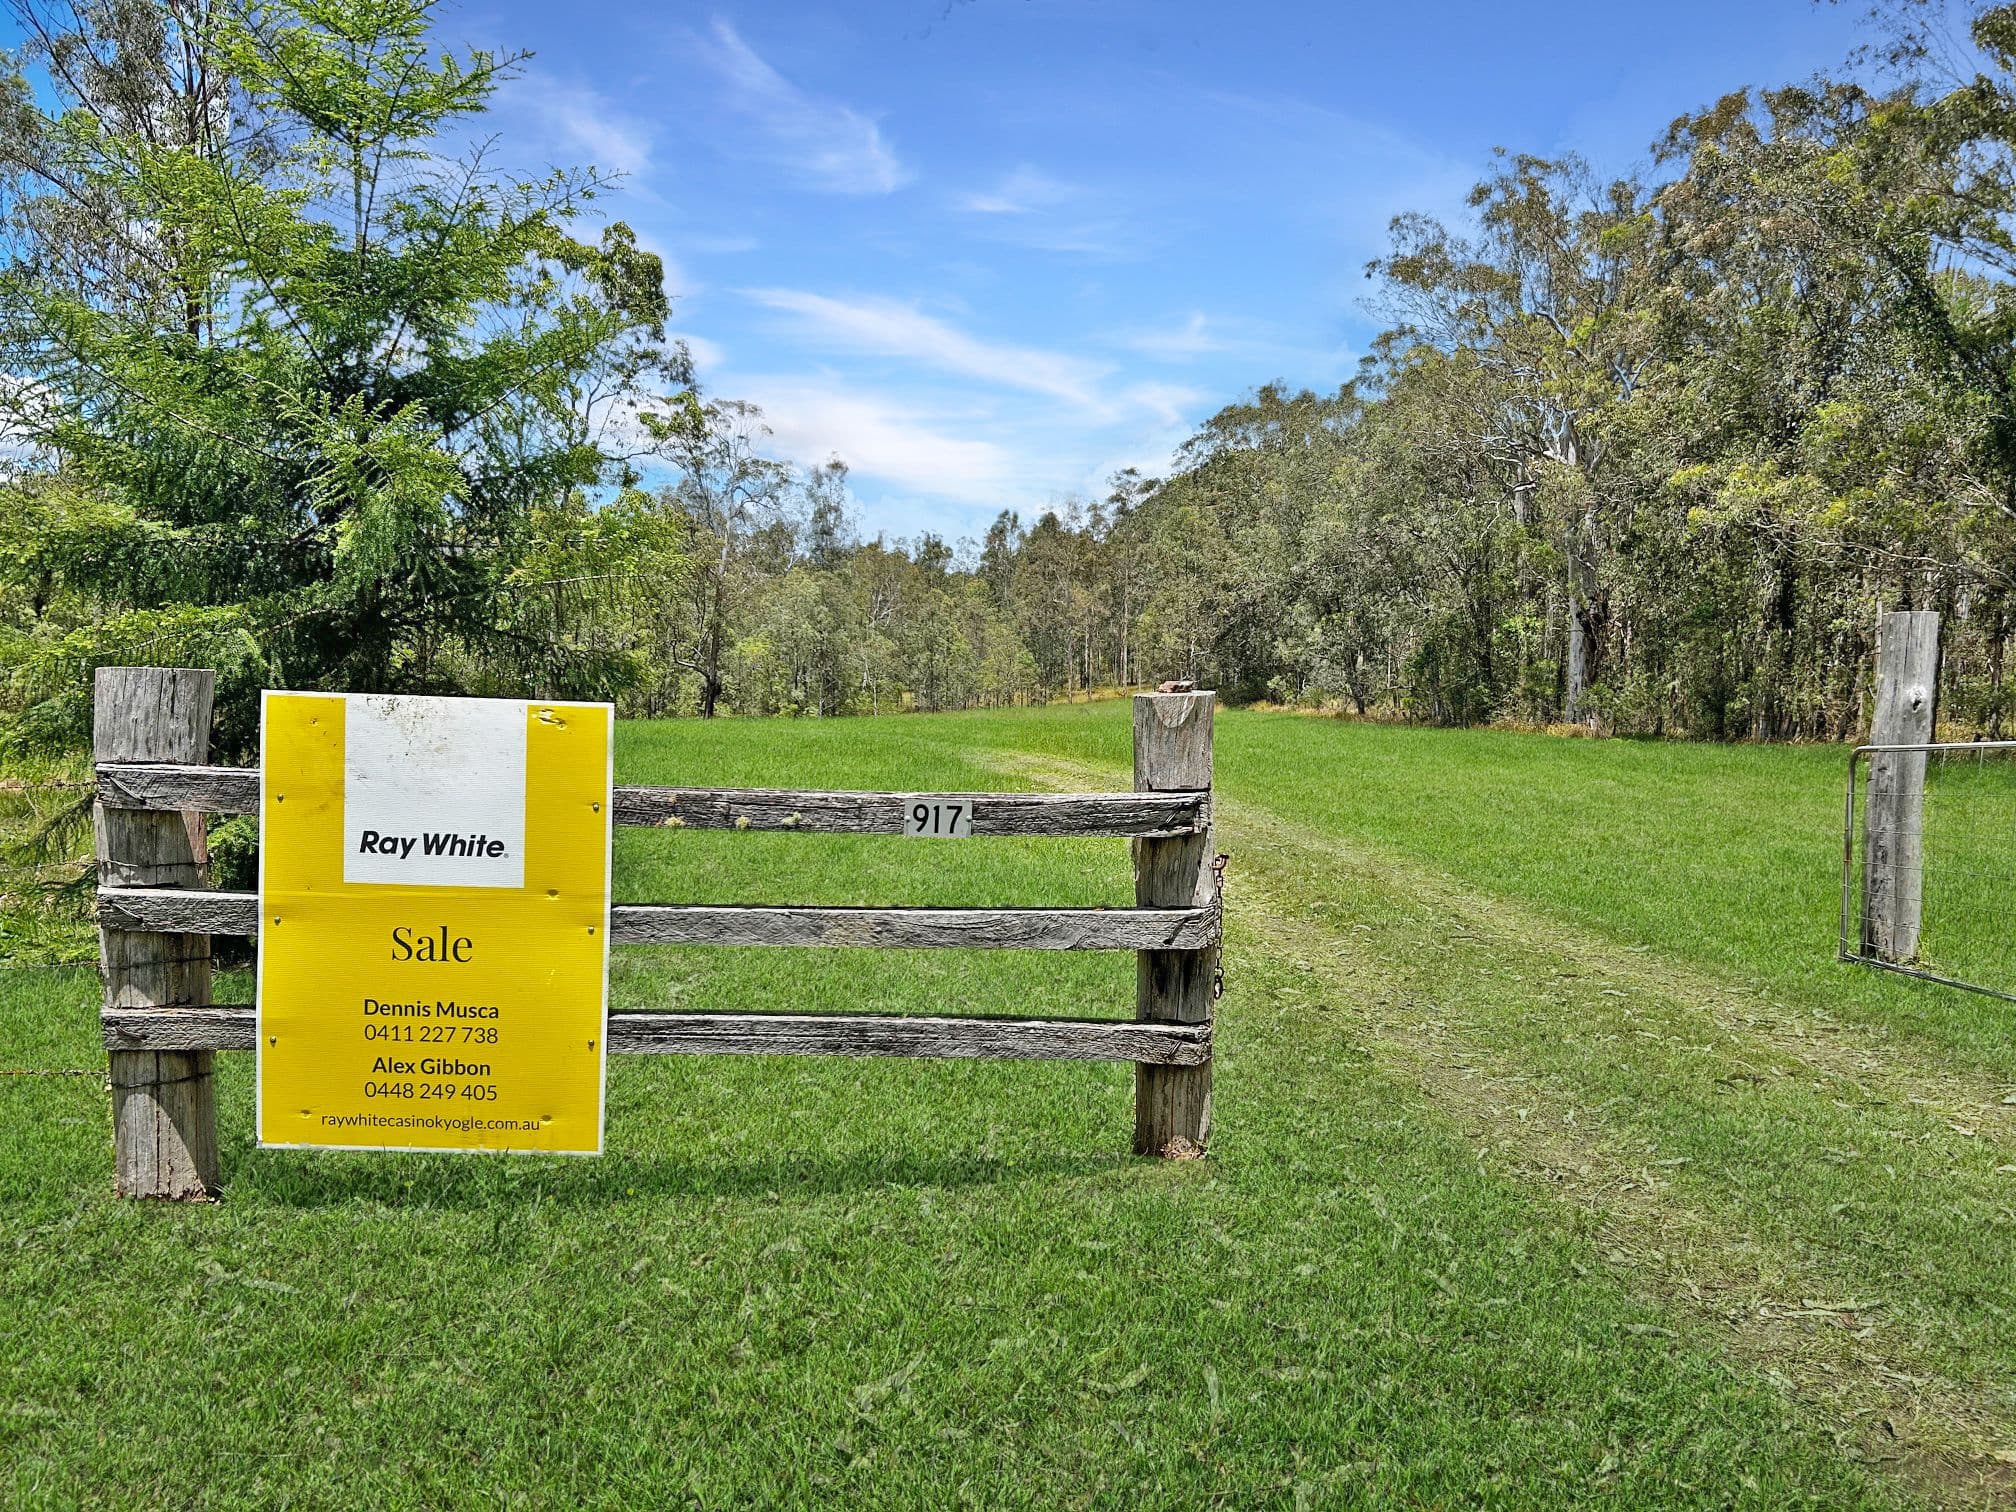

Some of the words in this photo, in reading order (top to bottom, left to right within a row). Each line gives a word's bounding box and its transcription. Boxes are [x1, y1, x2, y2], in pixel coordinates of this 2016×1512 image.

[913, 804, 963, 833] 917
[359, 830, 417, 859] Ray
[423, 833, 506, 858] White
[391, 926, 474, 963] Sale
[364, 998, 431, 1018] Dennis
[436, 1001, 500, 1020] Musca
[364, 1024, 413, 1042] 0411
[419, 1026, 456, 1044] 227
[461, 1026, 498, 1044] 738
[372, 1058, 416, 1076] Alex
[420, 1057, 491, 1077] Gibbon
[364, 1081, 415, 1099] 0448
[419, 1083, 456, 1101] 249
[461, 1083, 498, 1102] 405
[321, 1112, 541, 1134] raywhitecasinokyogle.com.au
